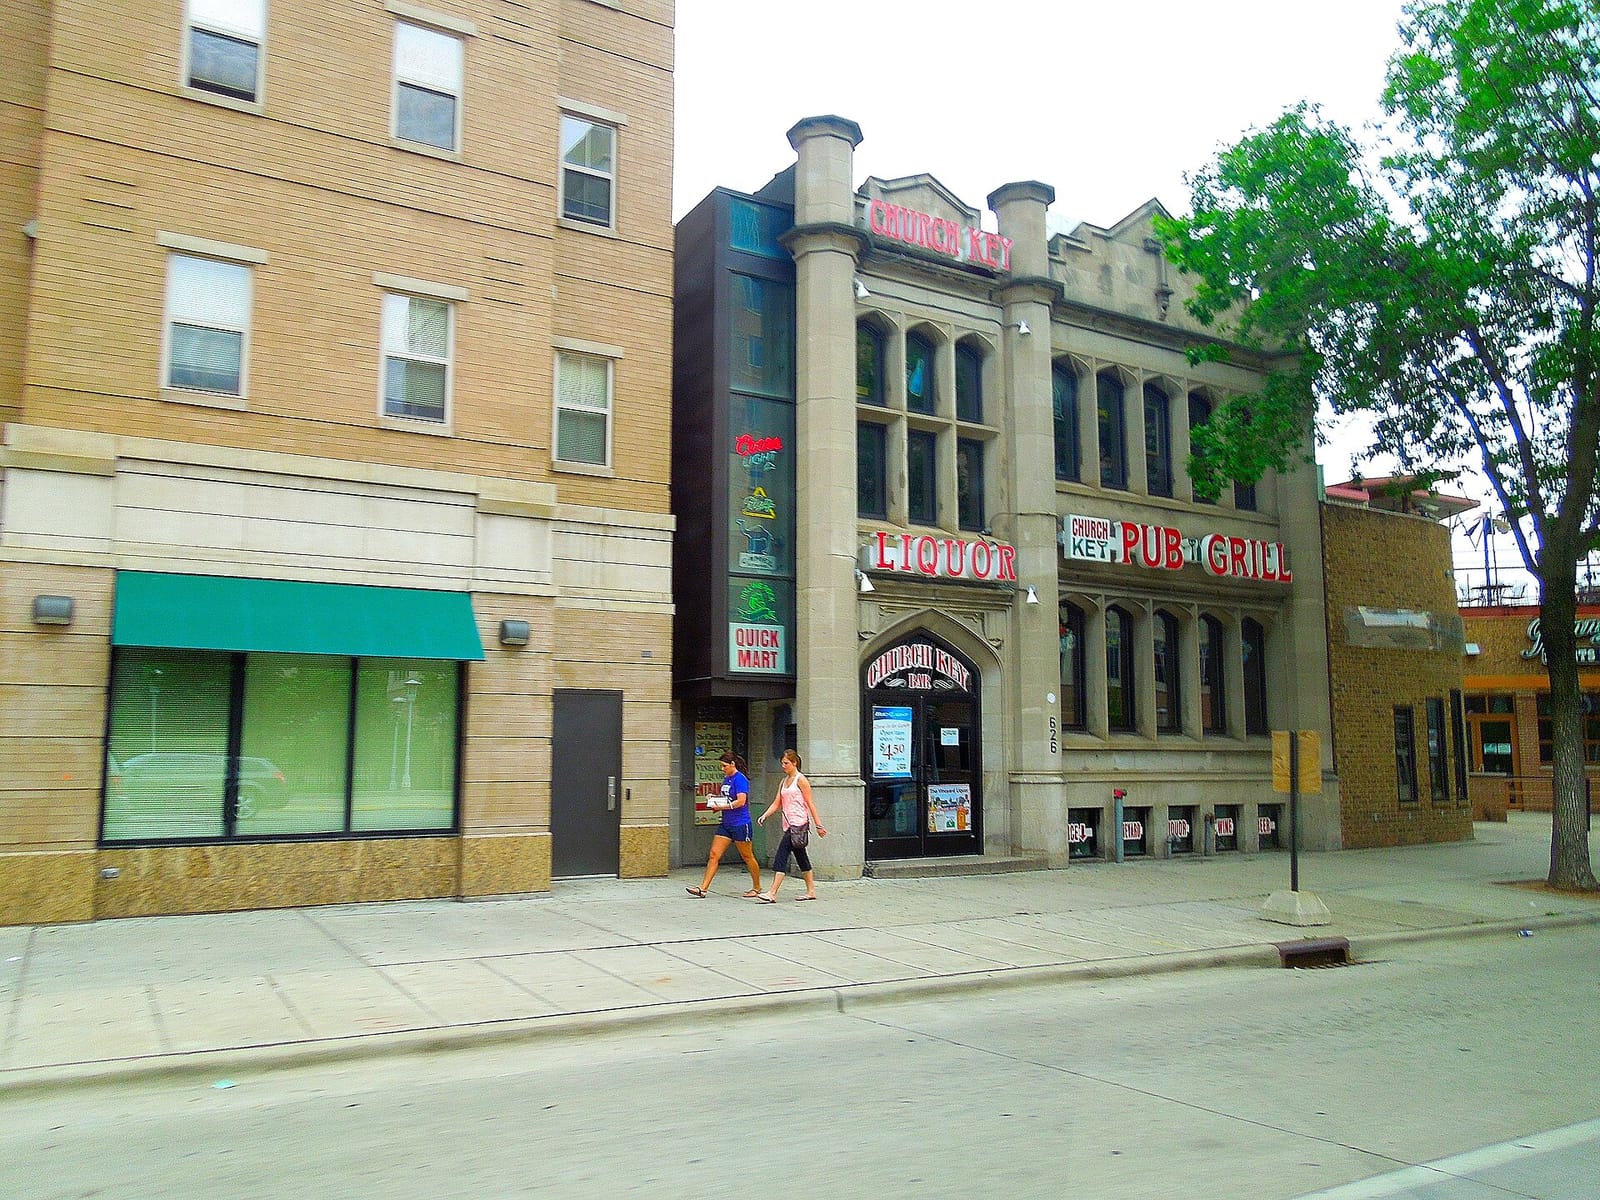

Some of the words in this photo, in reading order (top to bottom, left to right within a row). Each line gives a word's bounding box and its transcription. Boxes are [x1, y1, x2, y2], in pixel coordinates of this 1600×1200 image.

[870, 199, 960, 257] CHURCH
[968, 226, 1014, 271] KEY
[1072, 518, 1108, 540] CHURCH
[876, 531, 1017, 580] LIQUOR
[1072, 537, 1108, 559] KEY
[1120, 521, 1184, 570] PUB
[1207, 533, 1293, 583] GRILL
[736, 628, 779, 648] QUICK
[737, 649, 778, 669] MART
[868, 643, 933, 689] CHURCH
[935, 647, 970, 692] KEY
[908, 673, 932, 689] BAR
[1049, 716, 1057, 754] 626
